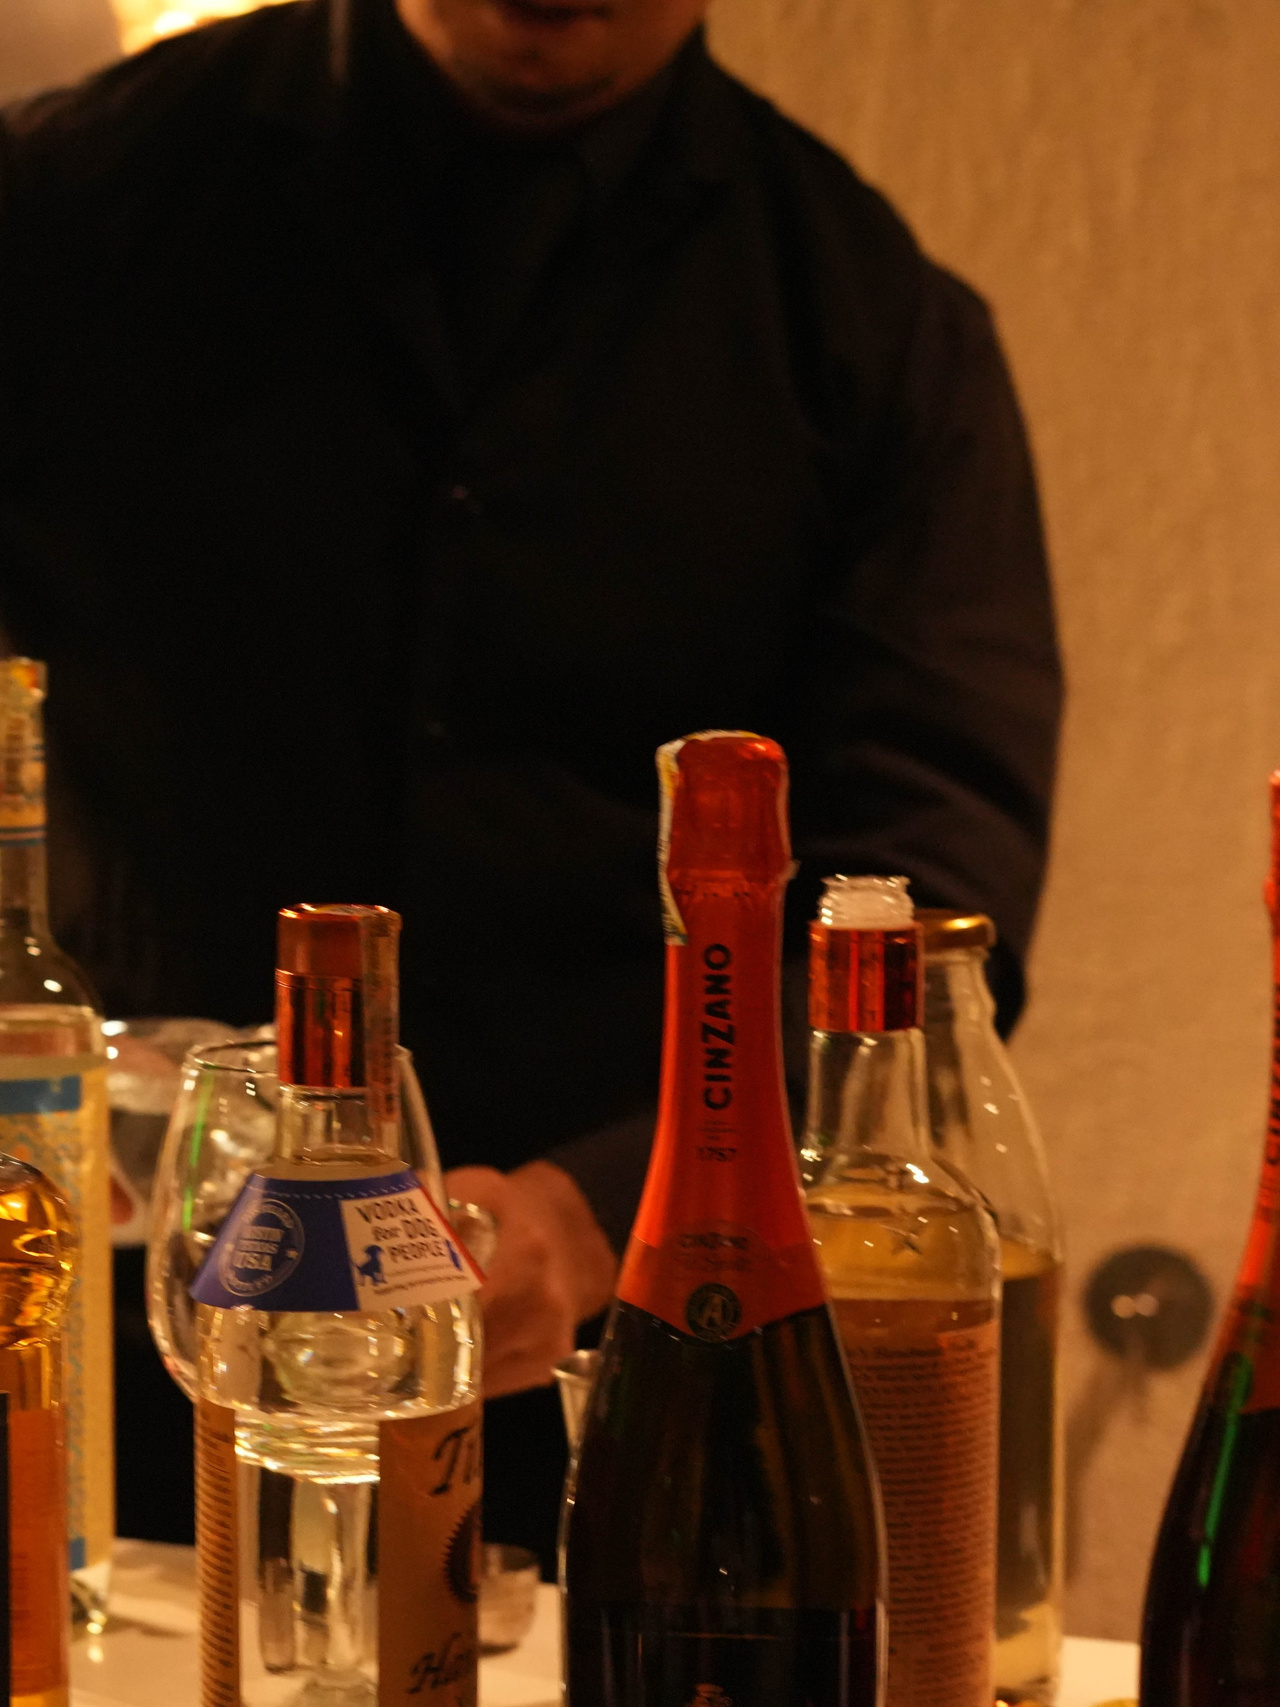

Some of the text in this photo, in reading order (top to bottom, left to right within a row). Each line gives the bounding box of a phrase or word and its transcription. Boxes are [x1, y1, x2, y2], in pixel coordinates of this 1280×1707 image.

[700, 942, 736, 1111] CINZANO
[354, 1197, 421, 1223] VODKA
[389, 1240, 446, 1263] PEOPLE
